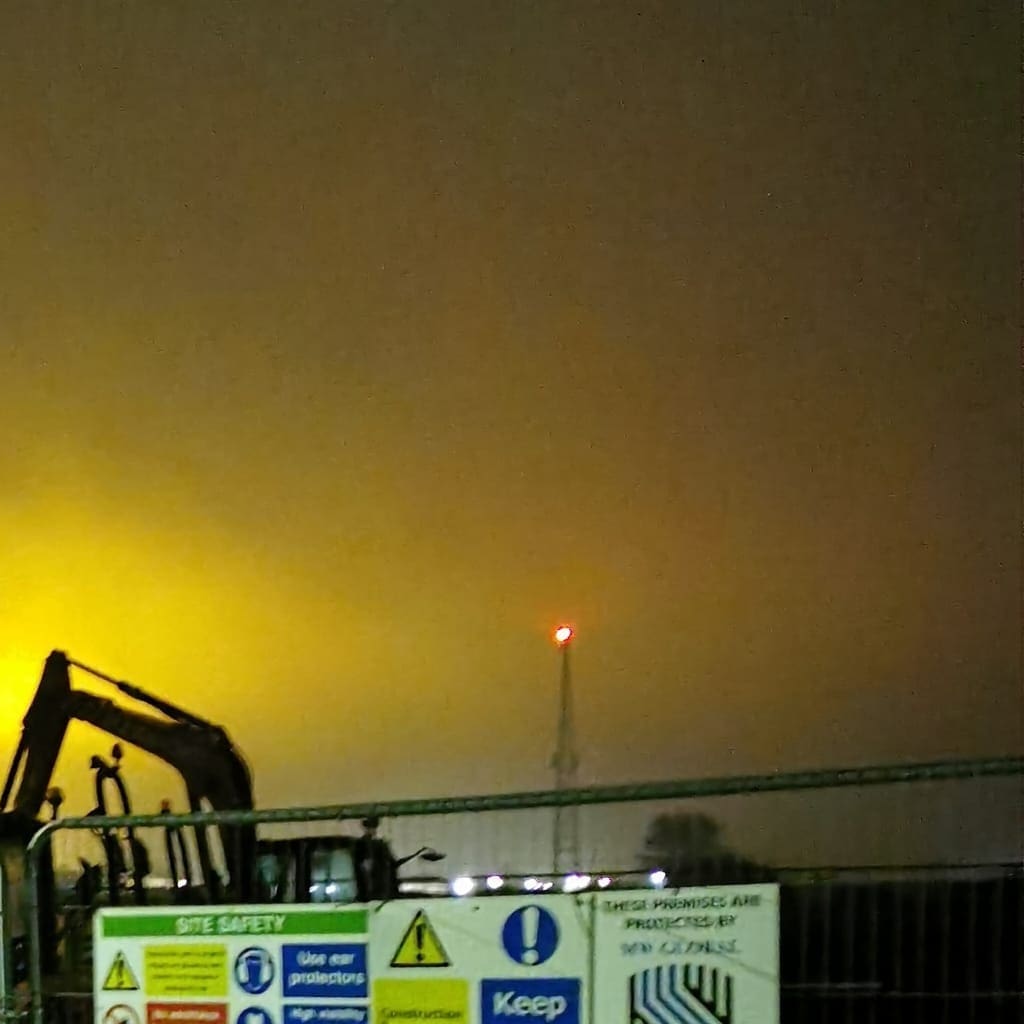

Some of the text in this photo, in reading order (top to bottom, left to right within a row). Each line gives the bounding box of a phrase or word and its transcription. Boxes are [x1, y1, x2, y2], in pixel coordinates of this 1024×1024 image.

[653, 897, 726, 910] PREMISES
[730, 894, 762, 907] ARE
[176, 914, 285, 935] SITE SAFETY
[297, 950, 355, 967] Use ear
[288, 970, 365, 987] protectors
[380, 1006, 462, 1021] Construction
[492, 990, 568, 1022] Keep
